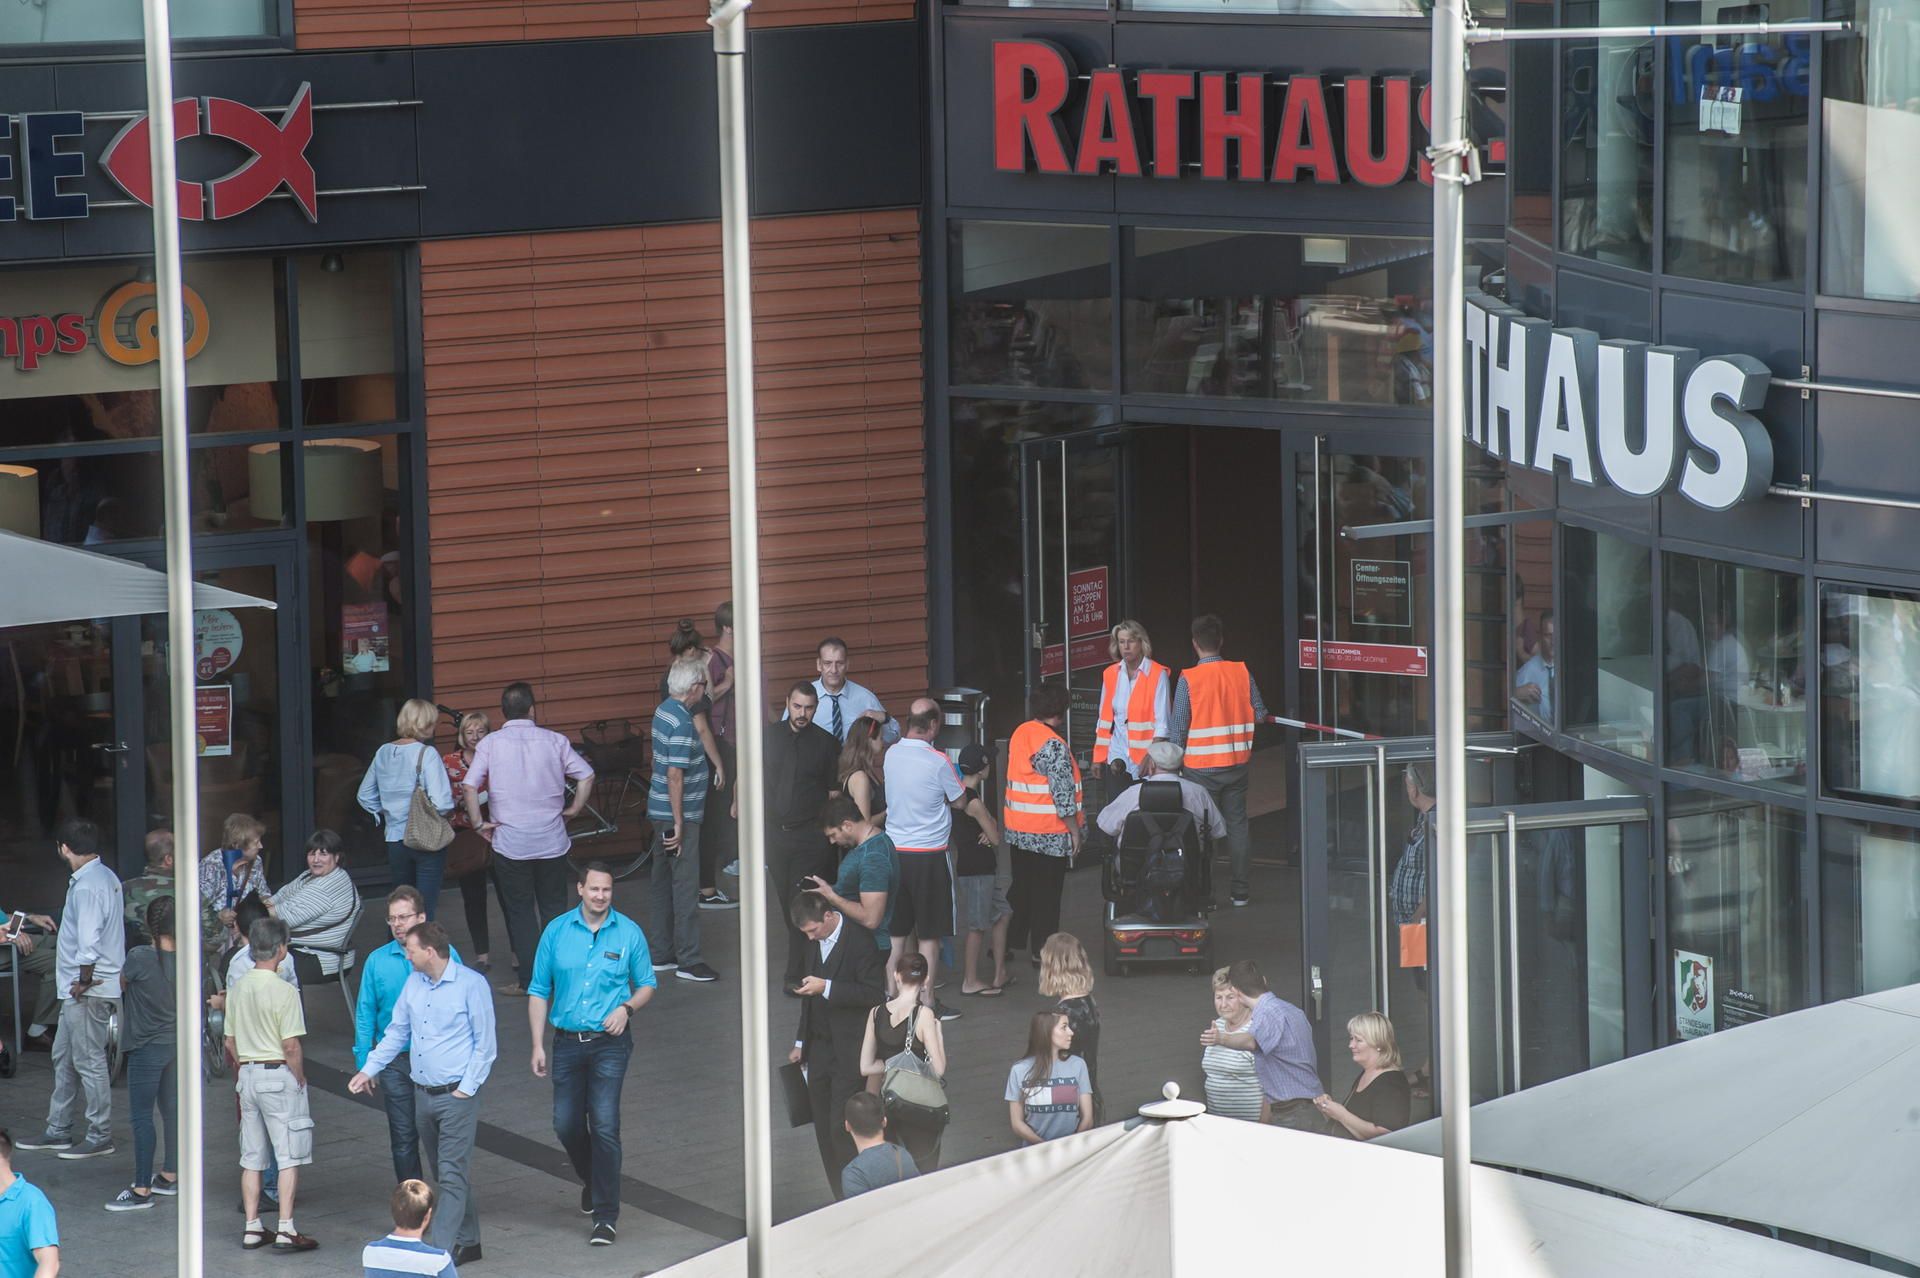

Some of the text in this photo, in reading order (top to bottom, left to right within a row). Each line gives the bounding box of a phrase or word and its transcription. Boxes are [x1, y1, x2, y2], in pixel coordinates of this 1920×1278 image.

[1463, 297, 1762, 511] THAUS
[1072, 580, 1103, 595] SONNTAG
[1073, 590, 1102, 605] SHOPPEN
[1073, 605, 1084, 615] AM
[1091, 610, 1104, 621] UHR
